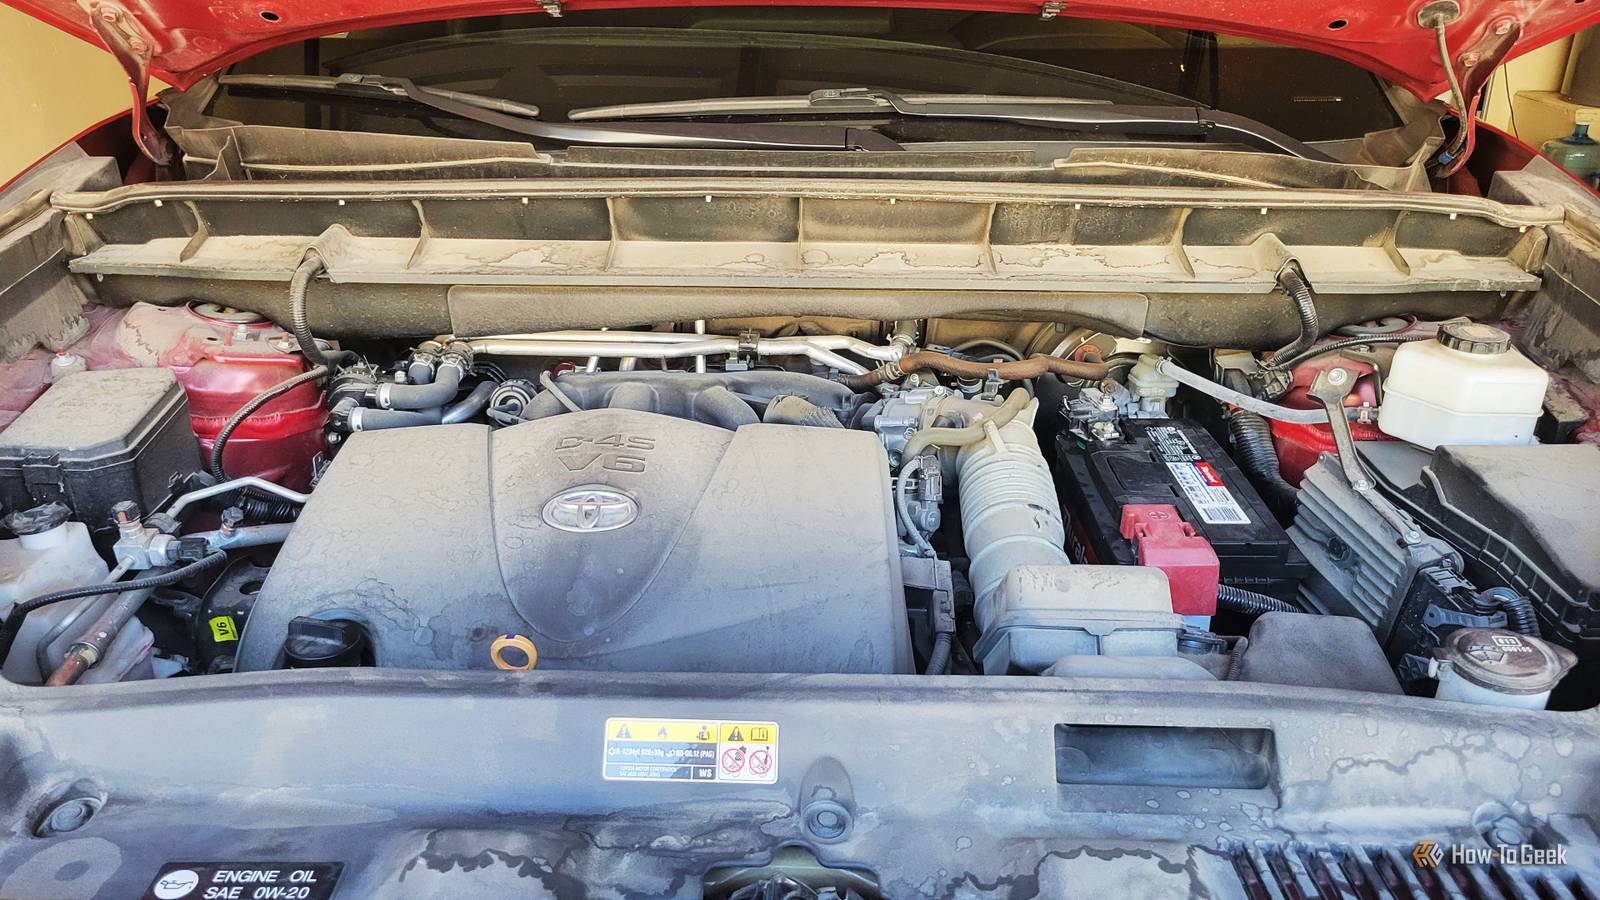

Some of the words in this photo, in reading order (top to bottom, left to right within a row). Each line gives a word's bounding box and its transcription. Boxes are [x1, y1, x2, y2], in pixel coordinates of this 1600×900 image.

[555, 433, 656, 450] D-4S
[558, 453, 646, 473] V6
[216, 621, 230, 636] V6
[699, 769, 712, 777] WS
[213, 870, 280, 882] ENGINE
[290, 870, 317, 882] OIL
[203, 886, 243, 899] SAE
[253, 886, 310, 899] 0W-20
